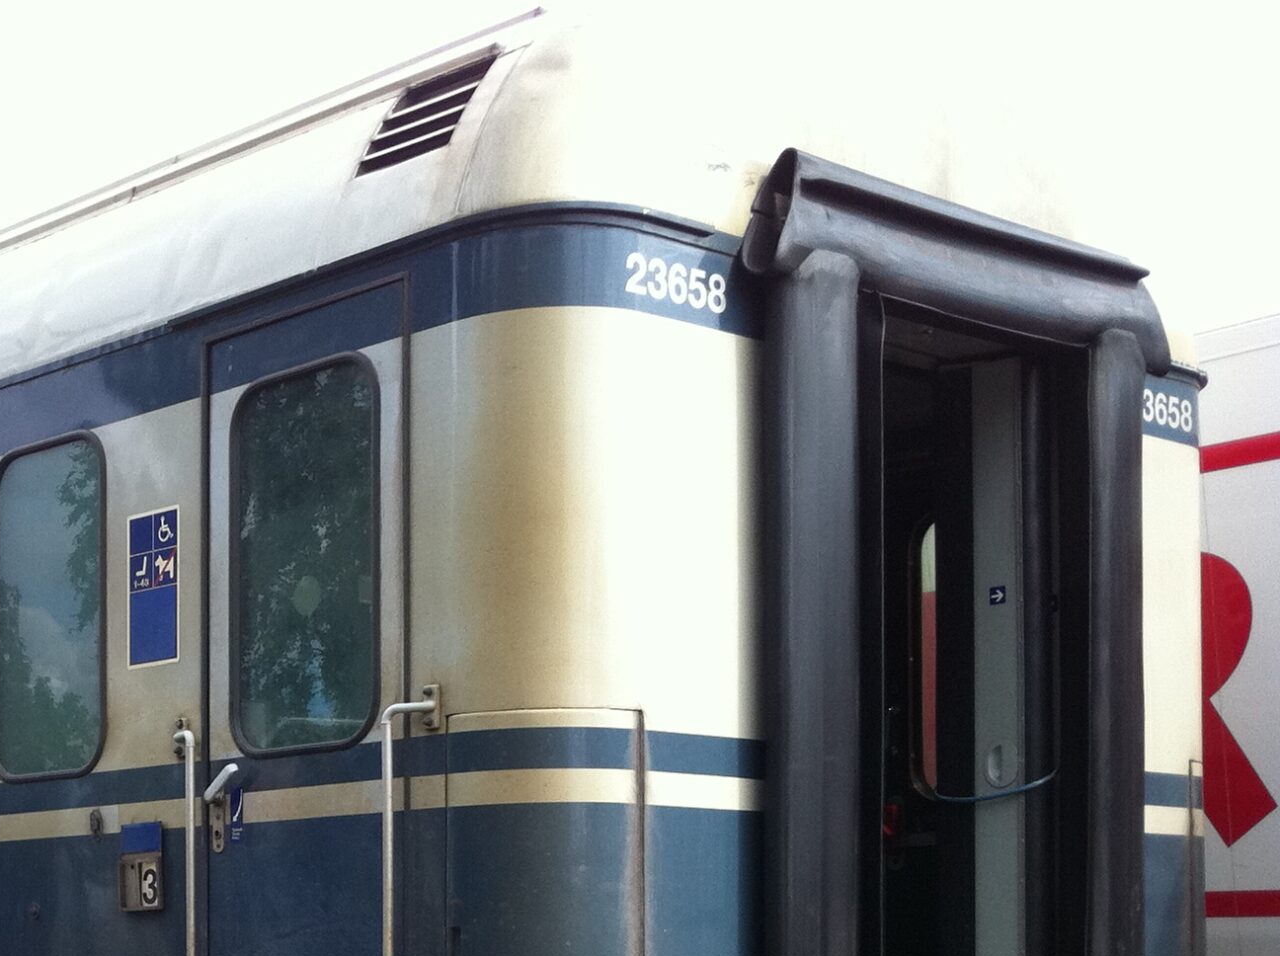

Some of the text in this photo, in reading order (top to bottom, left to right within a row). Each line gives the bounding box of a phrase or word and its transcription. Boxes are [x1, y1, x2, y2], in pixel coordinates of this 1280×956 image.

[624, 251, 727, 314] 23658
[1142, 387, 1193, 433] 3658
[142, 868, 158, 905] 3
